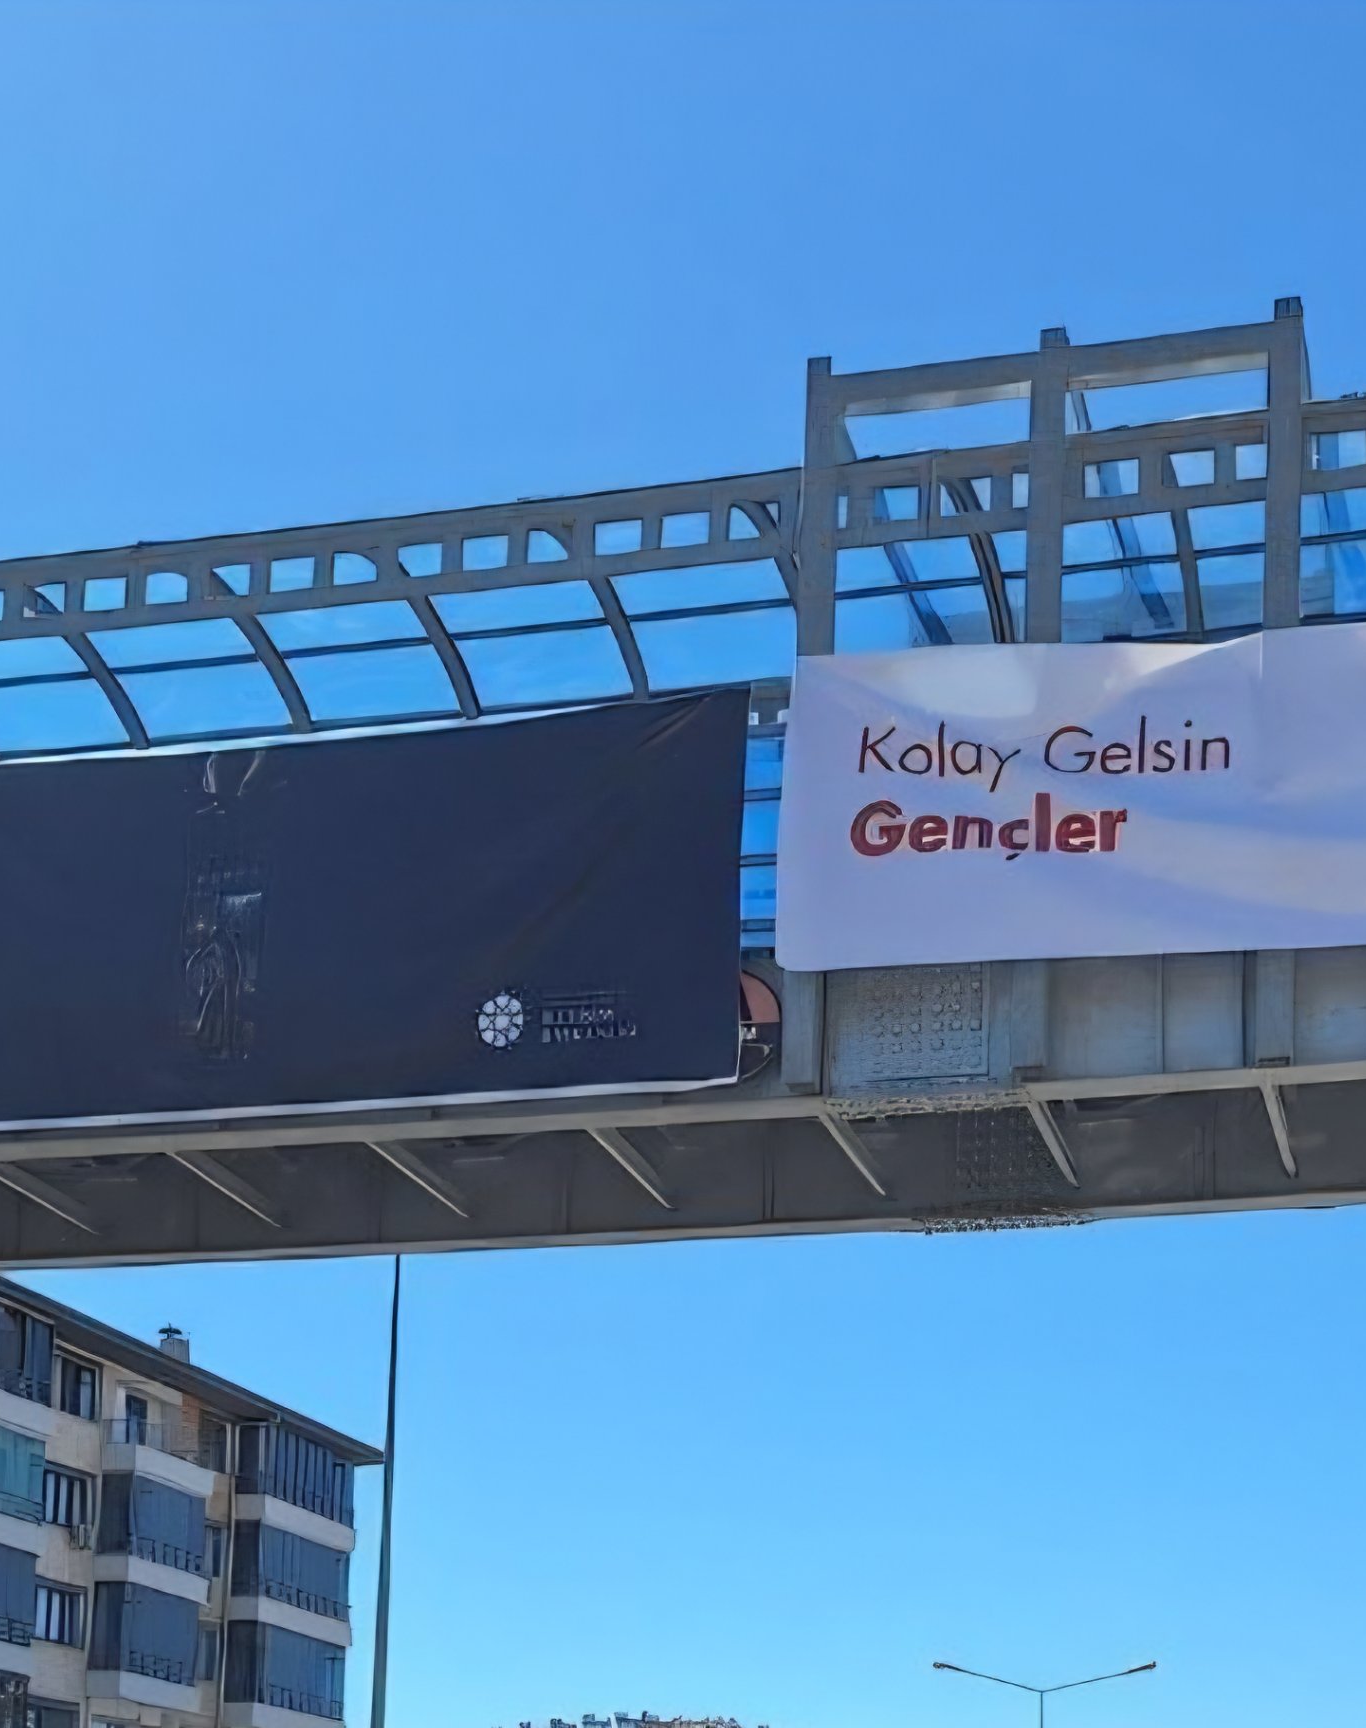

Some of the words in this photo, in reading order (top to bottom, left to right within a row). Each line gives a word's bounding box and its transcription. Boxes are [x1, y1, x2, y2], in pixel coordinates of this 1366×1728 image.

[858, 720, 1022, 793] Kolay
[1043, 715, 1231, 775] Gelsin
[850, 792, 1128, 861] Gençler
